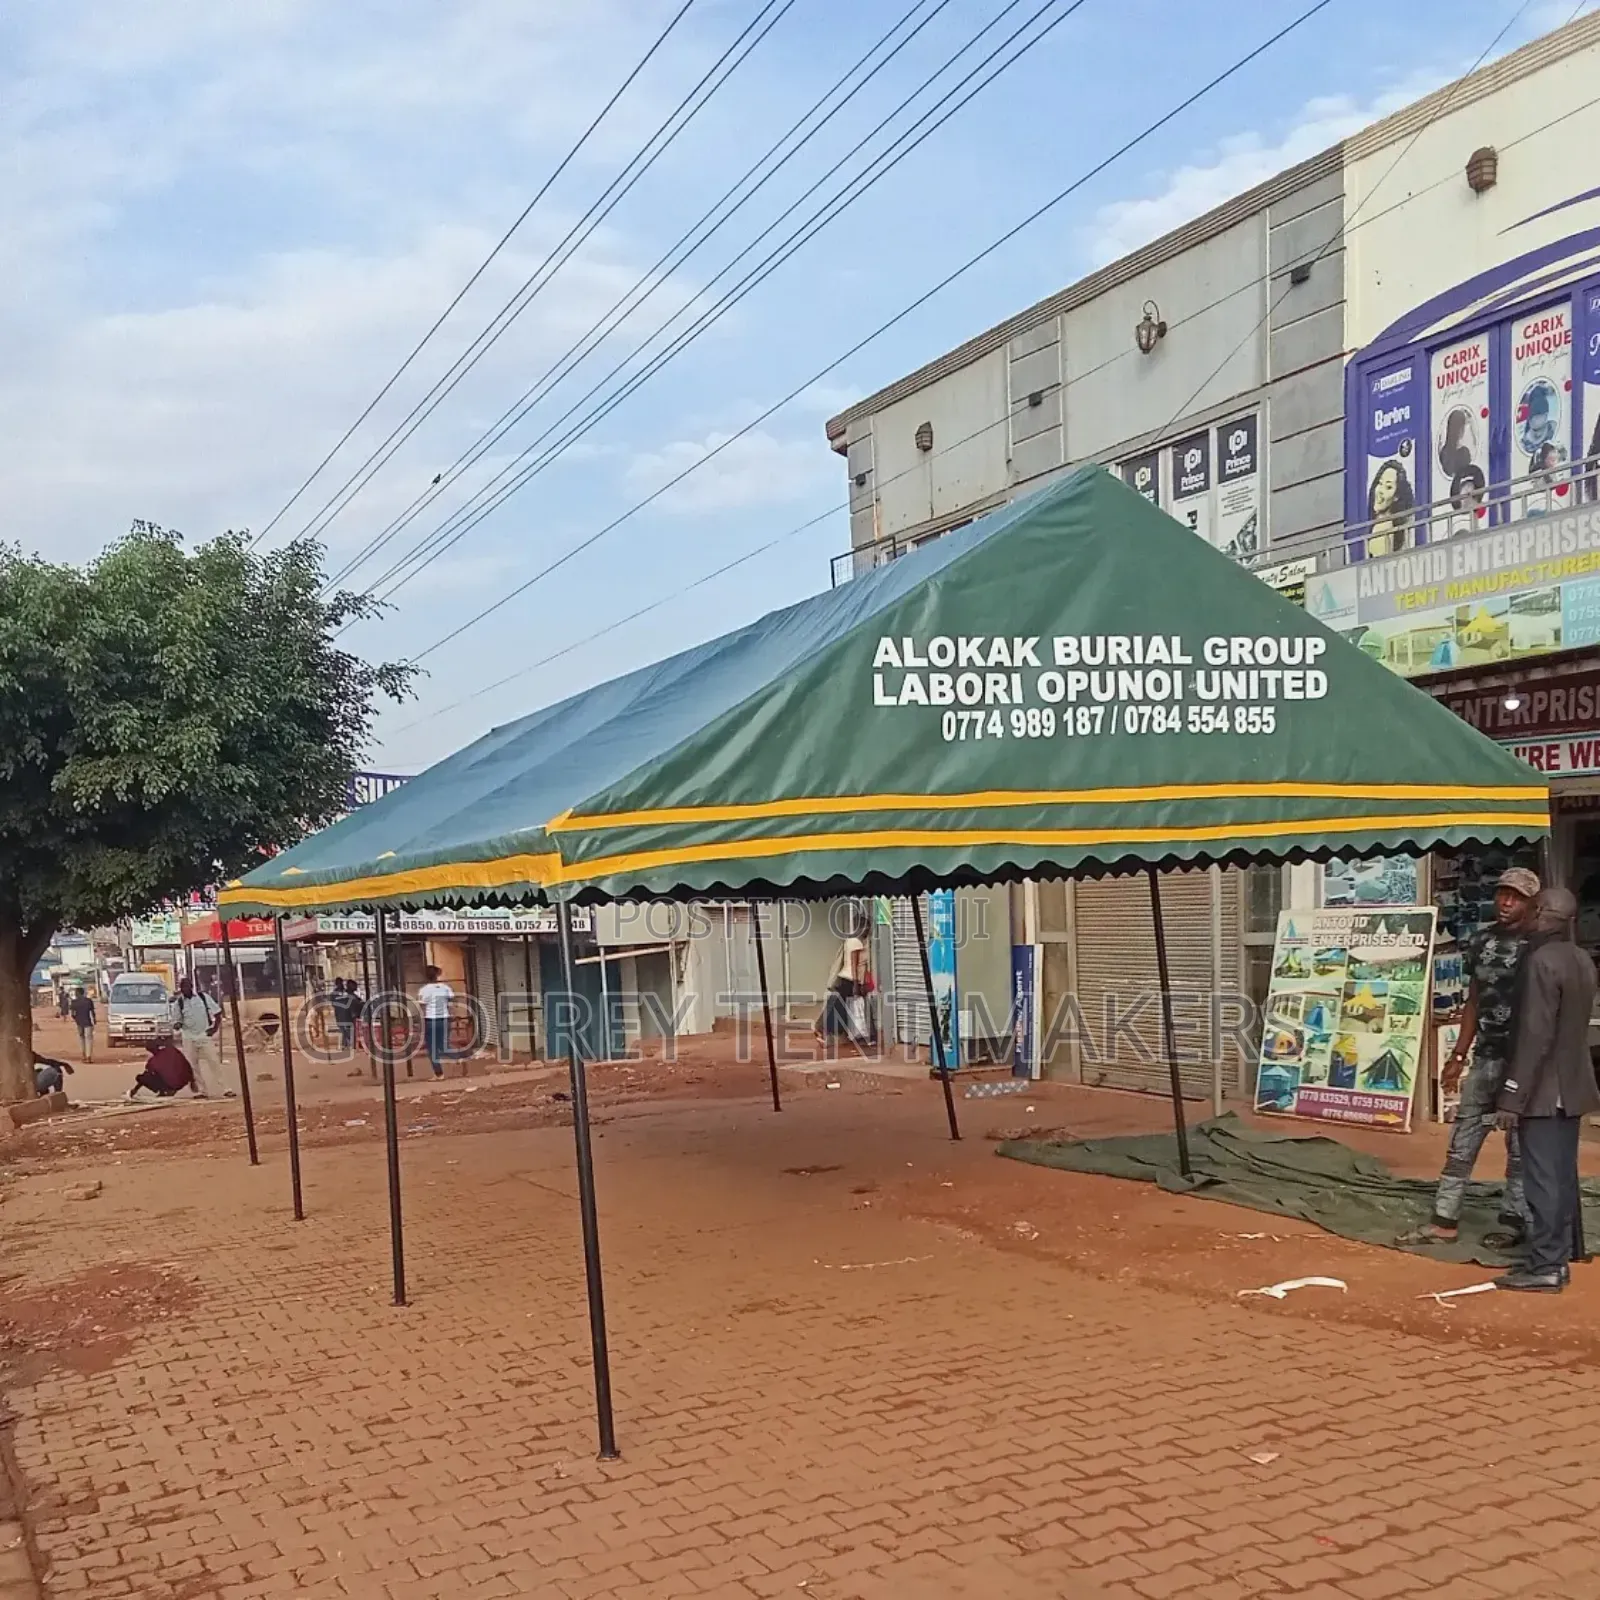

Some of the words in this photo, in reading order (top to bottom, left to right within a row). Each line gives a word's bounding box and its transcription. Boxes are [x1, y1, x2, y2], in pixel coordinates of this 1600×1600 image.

[1523, 313, 1564, 339] CARIX
[1443, 344, 1480, 369] CARIX
[1515, 329, 1572, 361] UNIQUE
[1437, 358, 1487, 389] UNIQUE
[1226, 454, 1251, 471] Prince
[1181, 472, 1204, 488] Prince
[1360, 550, 1446, 598] ANTOVID
[1453, 511, 1600, 576] ENTERPRISES
[1279, 565, 1306, 582] Salon
[1395, 587, 1440, 611] TENT
[872, 636, 1041, 668] ALOKAK
[1053, 635, 1192, 666] BURIAL
[1203, 637, 1327, 665] GROUP
[873, 672, 1023, 706] LABORI
[1037, 669, 1183, 703] OPUNOI
[1196, 670, 1328, 700] UNITED
[1450, 685, 1600, 728] ENTERPRIS
[942, 709, 1003, 741] 0774
[1011, 708, 1056, 738] 989
[1063, 706, 1105, 738] 187
[1124, 705, 1182, 735] 0784
[1187, 705, 1230, 734] 554
[1234, 706, 1276, 734] 855
[439, 920, 465, 930] 0776
[468, 920, 513, 931] 819850,
[515, 920, 541, 930] 0752
[1313, 916, 1370, 929] ANTOVID
[1312, 933, 1398, 947] ENTERPRISES
[1398, 933, 1428, 947] LTD.
[1014, 970, 1024, 1008] Agent
